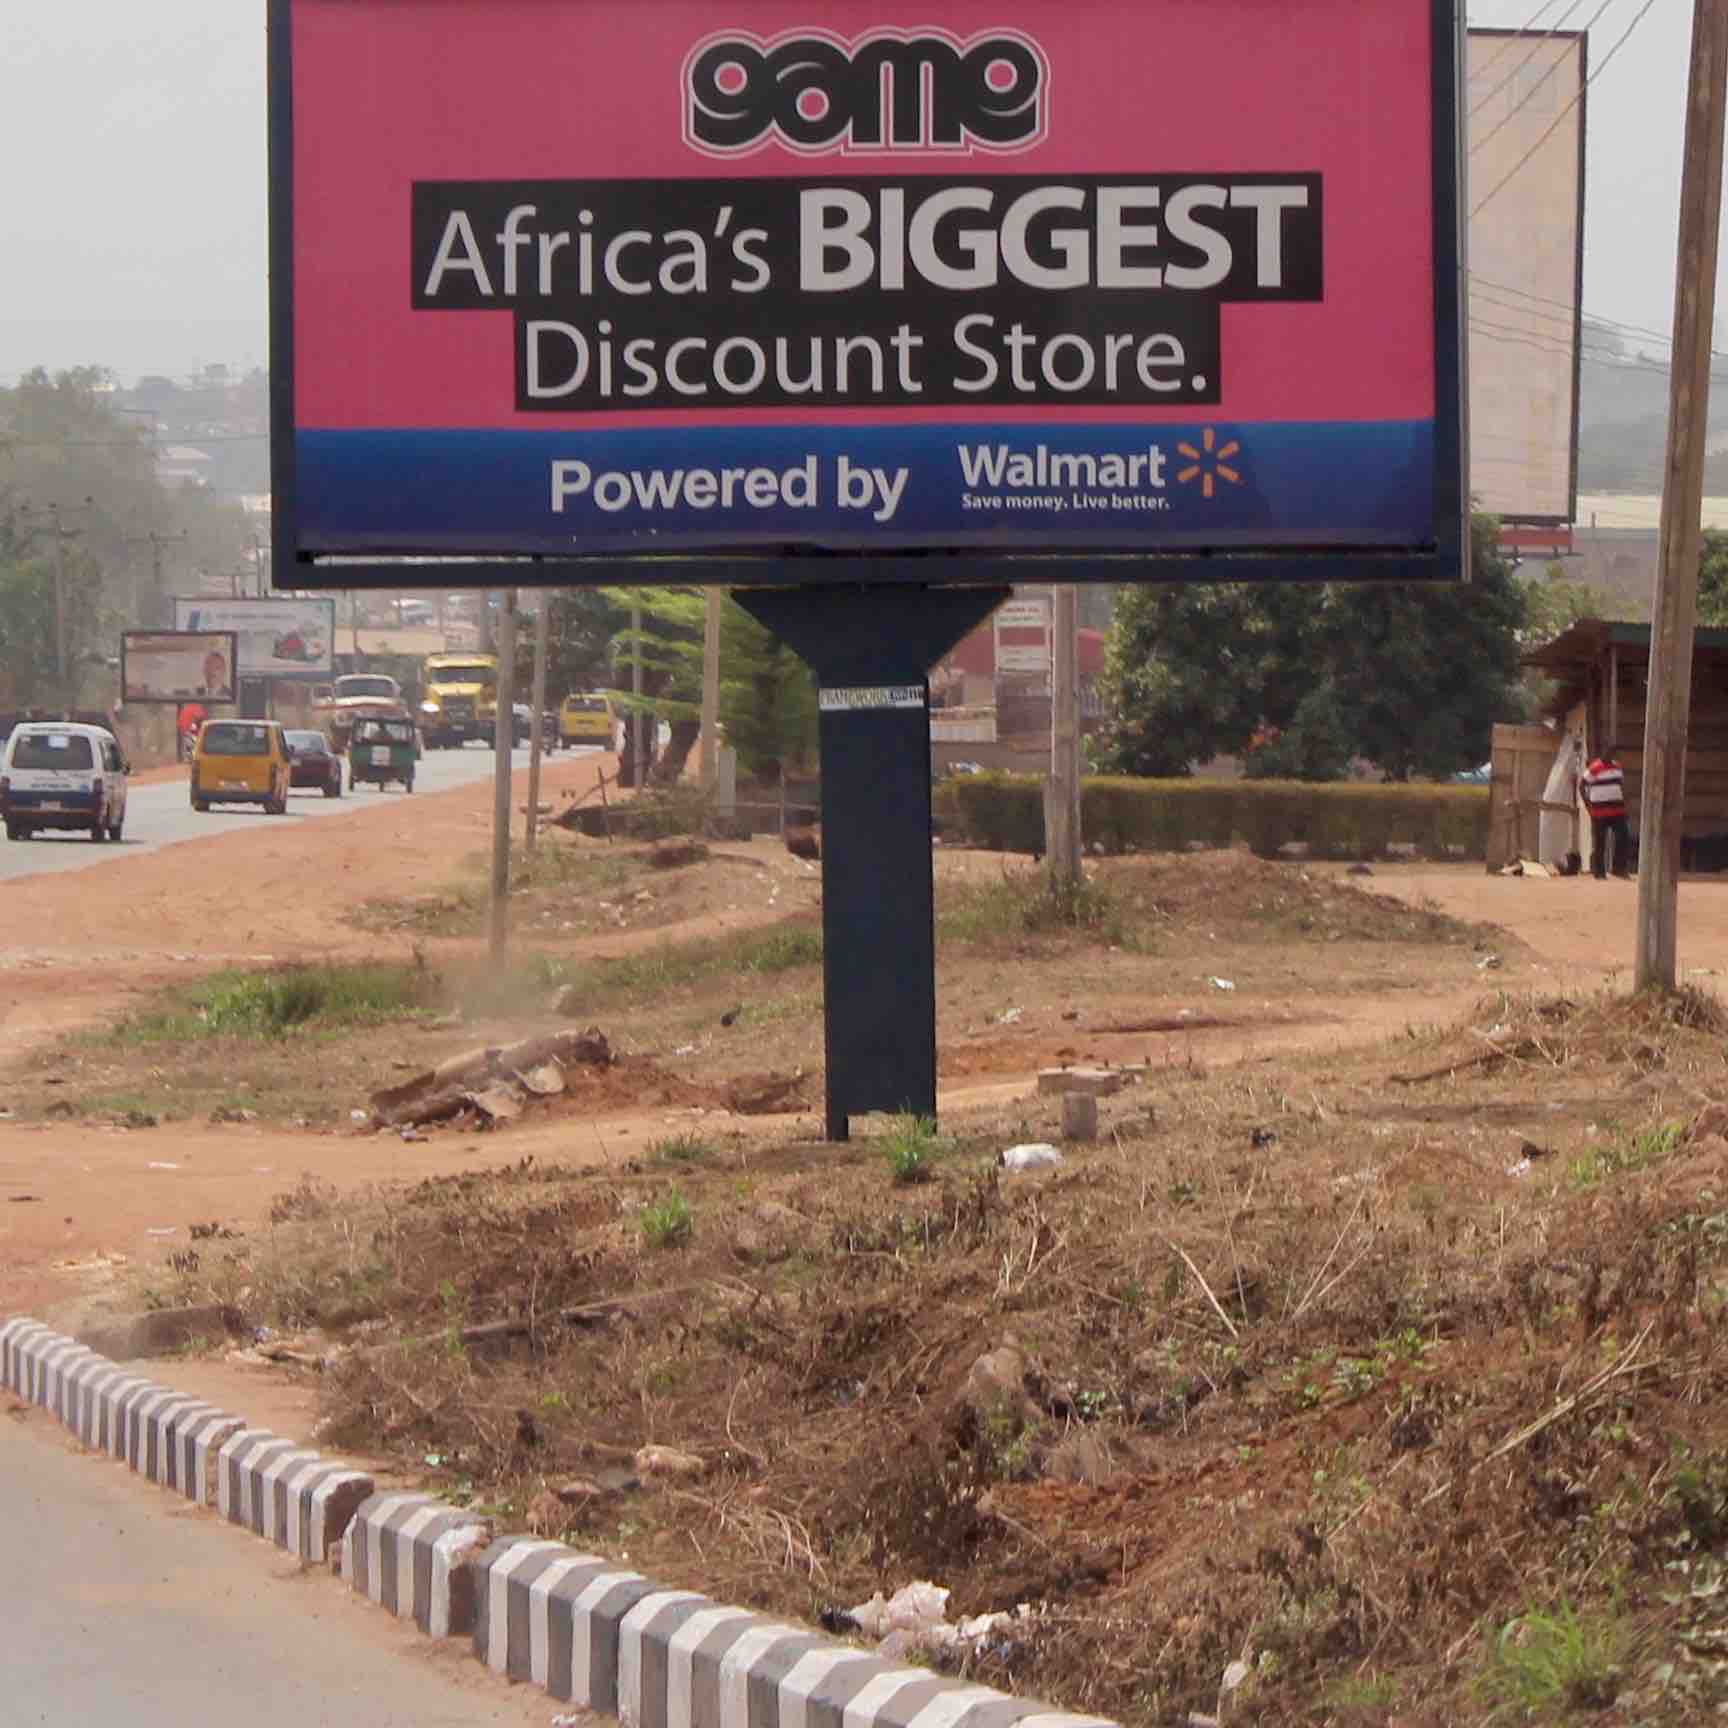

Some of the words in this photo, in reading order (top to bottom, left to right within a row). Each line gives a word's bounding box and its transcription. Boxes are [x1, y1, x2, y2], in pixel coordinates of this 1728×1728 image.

[685, 28, 1047, 156] game
[423, 204, 771, 297] Africa's
[798, 184, 1308, 292] BIGGEST
[524, 316, 924, 399] Discount
[952, 311, 1208, 394] Store.
[550, 456, 817, 513] Powered
[836, 455, 909, 521] by
[957, 444, 1166, 488] Walmart
[962, 493, 1002, 510] Save
[1006, 494, 1068, 512] money.
[1072, 493, 1108, 510] Live
[1112, 493, 1171, 510] better.
